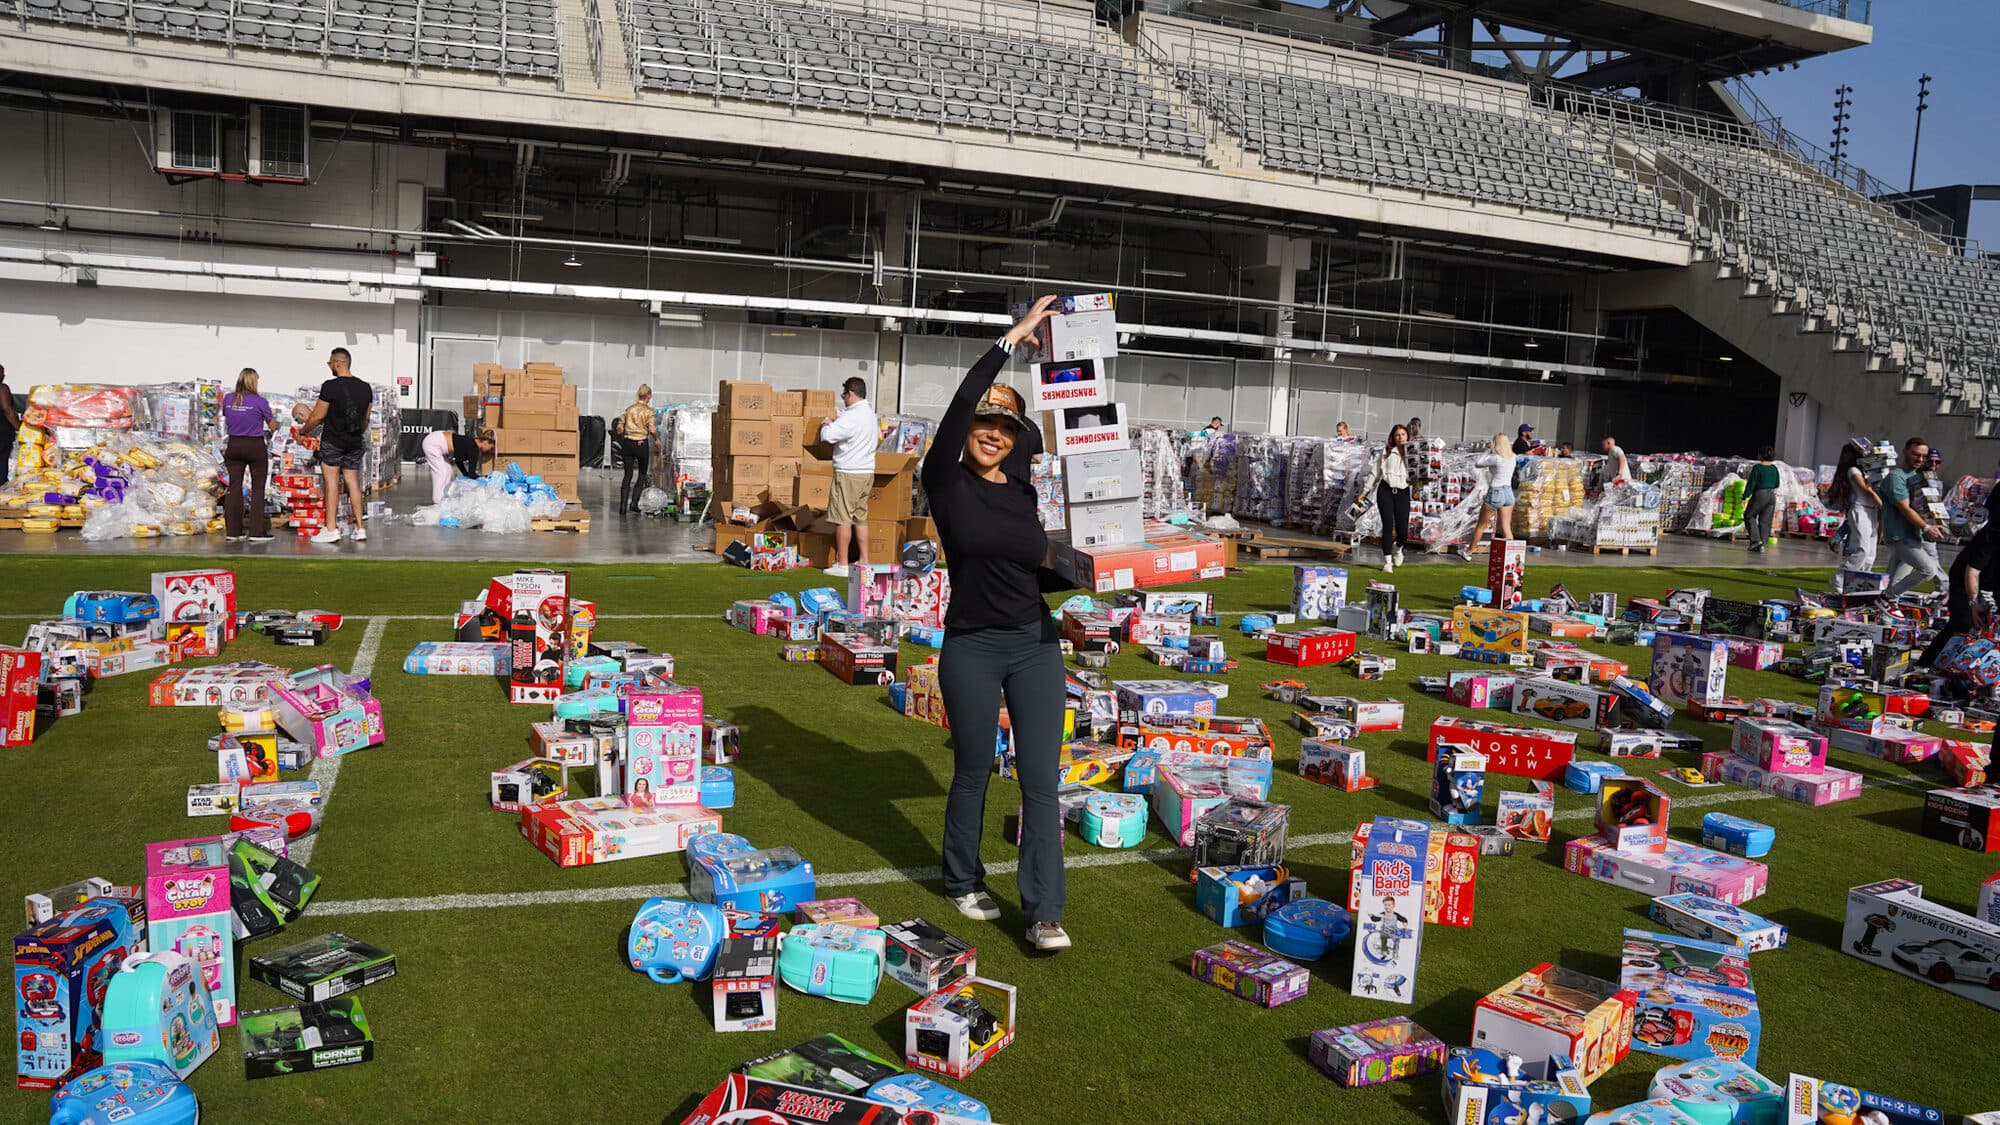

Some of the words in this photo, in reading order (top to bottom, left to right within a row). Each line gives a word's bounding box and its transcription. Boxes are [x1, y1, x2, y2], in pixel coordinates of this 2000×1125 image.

[1042, 387, 1097, 400] TRANSFORMERS
[1065, 432, 1120, 445] TRANSFORMERS
[1316, 639, 1349, 651] TYSON
[1320, 649, 1343, 659] MIKE
[1470, 737, 1552, 761] TYSON
[1483, 753, 1538, 770] MIKE
[1375, 861, 1410, 876] Kid's
[176, 879, 201, 891] ICE
[1375, 876, 1410, 889] Band
[165, 886, 215, 903] CREAM
[173, 897, 206, 911] STOP
[1901, 910, 1938, 930] PORSCHE
[1938, 921, 1956, 935] GT3
[1958, 928, 1969, 938] RS
[908, 1015, 933, 1025] SWAT
[1705, 1032, 1749, 1051] SIZZLIN'
[313, 1047, 363, 1060] HORNET
[777, 1089, 846, 1114] TYSON
[1801, 1080, 1813, 1117] SONIC
[774, 1101, 833, 1122] MIKE
[1464, 1097, 1477, 1125] ONIC
